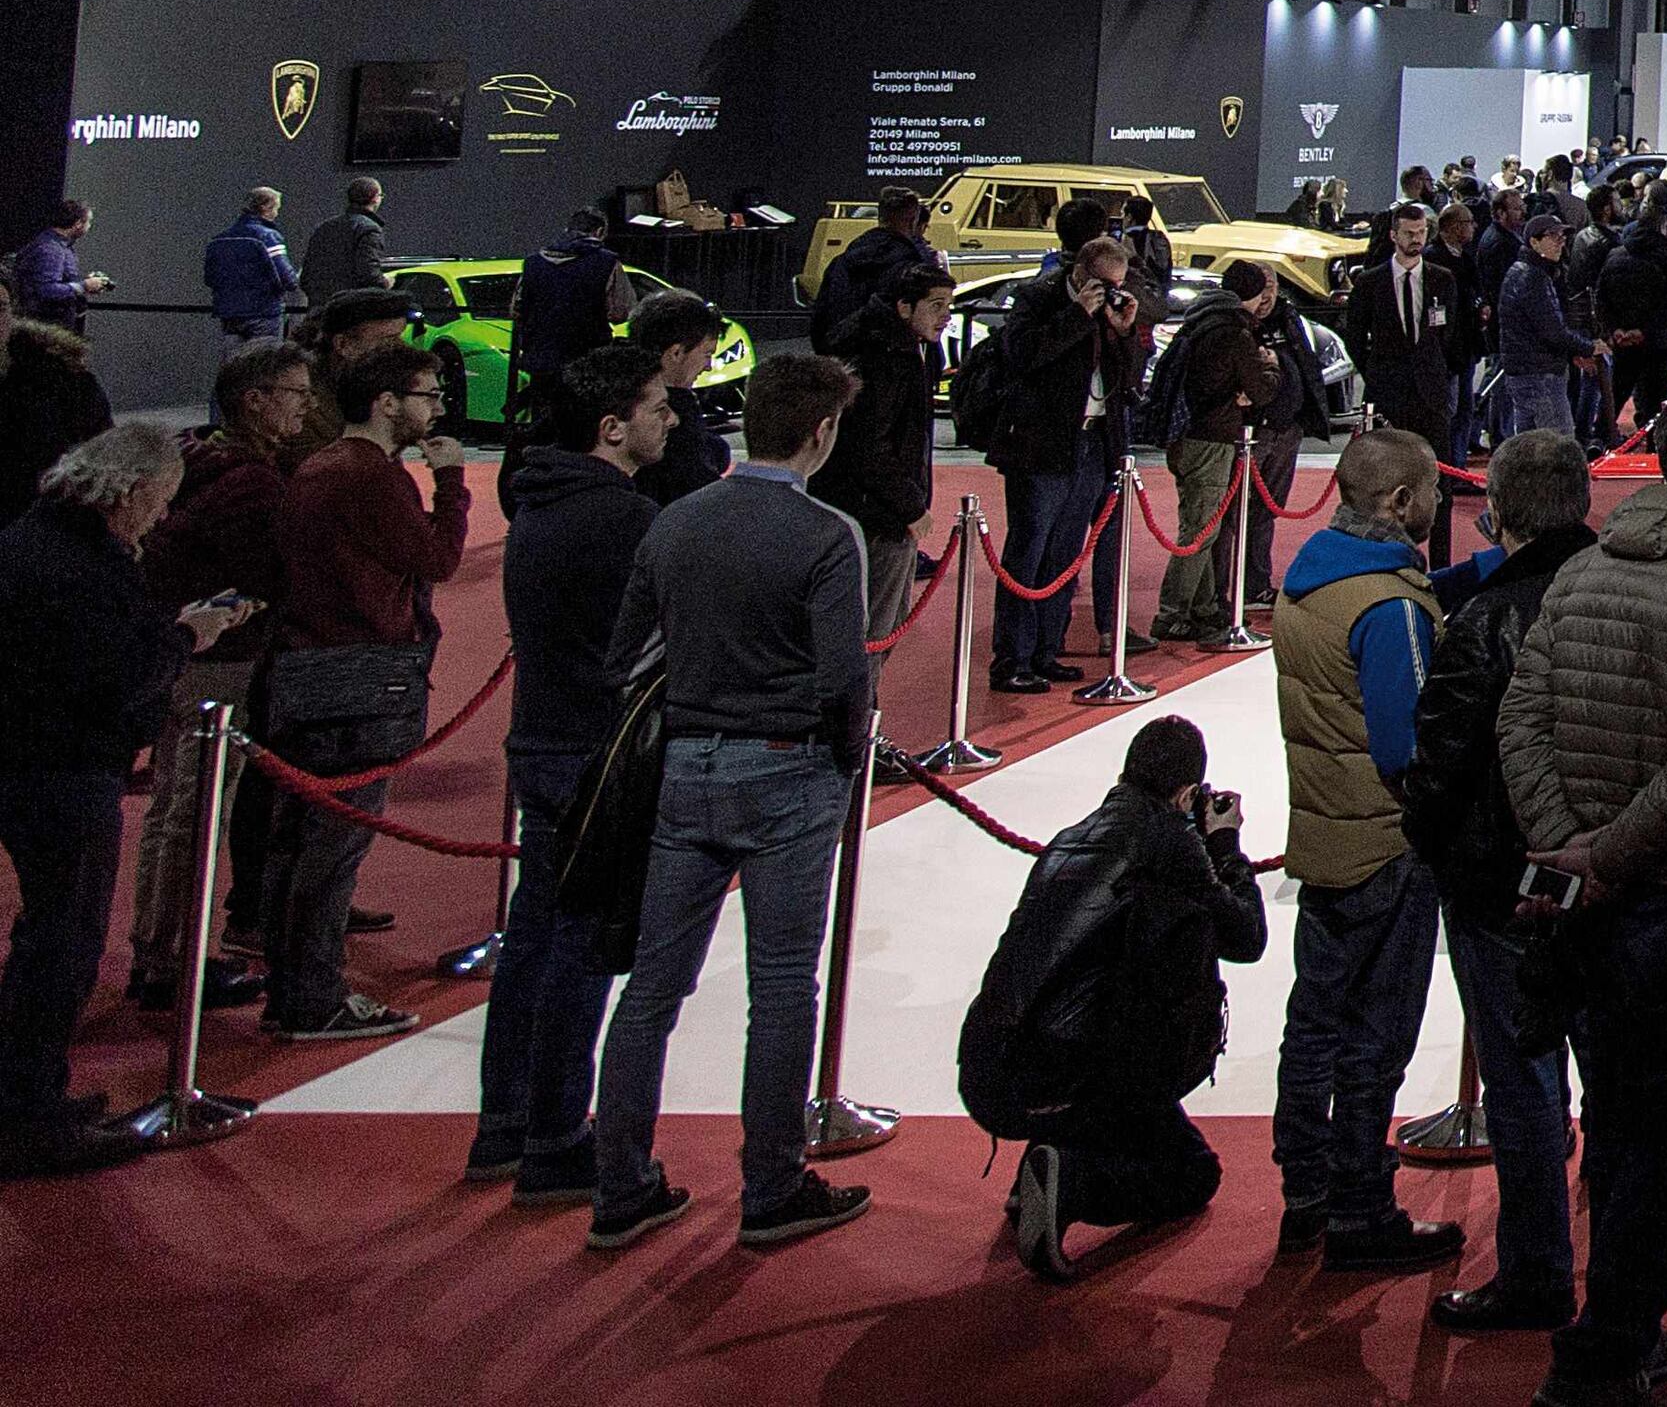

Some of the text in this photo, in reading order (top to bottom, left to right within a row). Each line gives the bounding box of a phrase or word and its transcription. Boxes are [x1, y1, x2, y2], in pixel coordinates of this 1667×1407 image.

[873, 70, 976, 81] Lamborghini Milano
[872, 83, 953, 92] Gruppo Bonaldi
[617, 99, 718, 136] Lamborghini
[870, 117, 985, 127] Viale Renato Serra, 61
[72, 114, 201, 145] rghini Milano
[870, 130, 940, 139] 20149 Milano
[1110, 127, 1196, 142] Lamborghini Milano
[890, 142, 904, 151] 02
[907, 142, 960, 151] 49790951
[1298, 147, 1334, 162] BENTLEY
[867, 167, 943, 176] www.bonaldi.it
